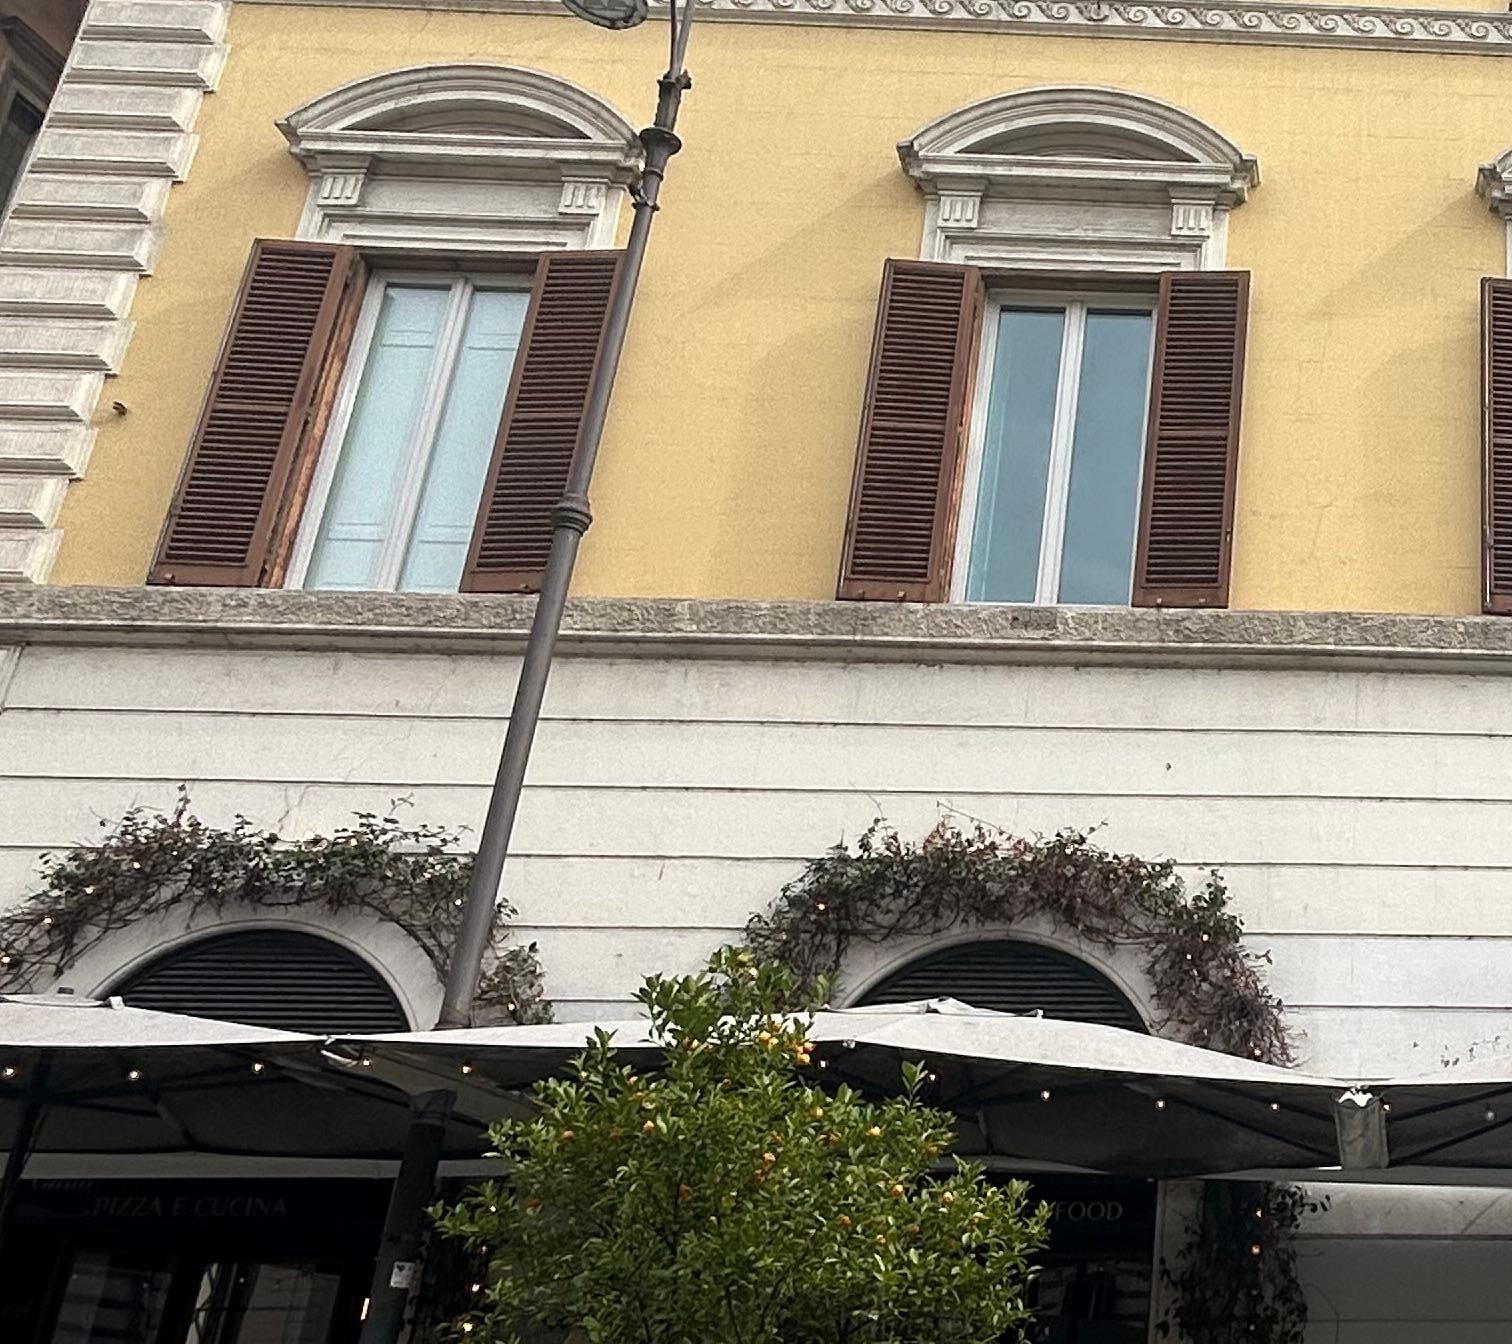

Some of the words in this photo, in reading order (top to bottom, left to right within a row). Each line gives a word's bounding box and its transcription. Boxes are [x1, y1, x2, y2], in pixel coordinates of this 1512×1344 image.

[93, 1196, 164, 1217] PIZZA
[171, 1196, 188, 1216] E
[192, 1196, 287, 1217] CUCINA
[1055, 1200, 1123, 1222] FOOD
